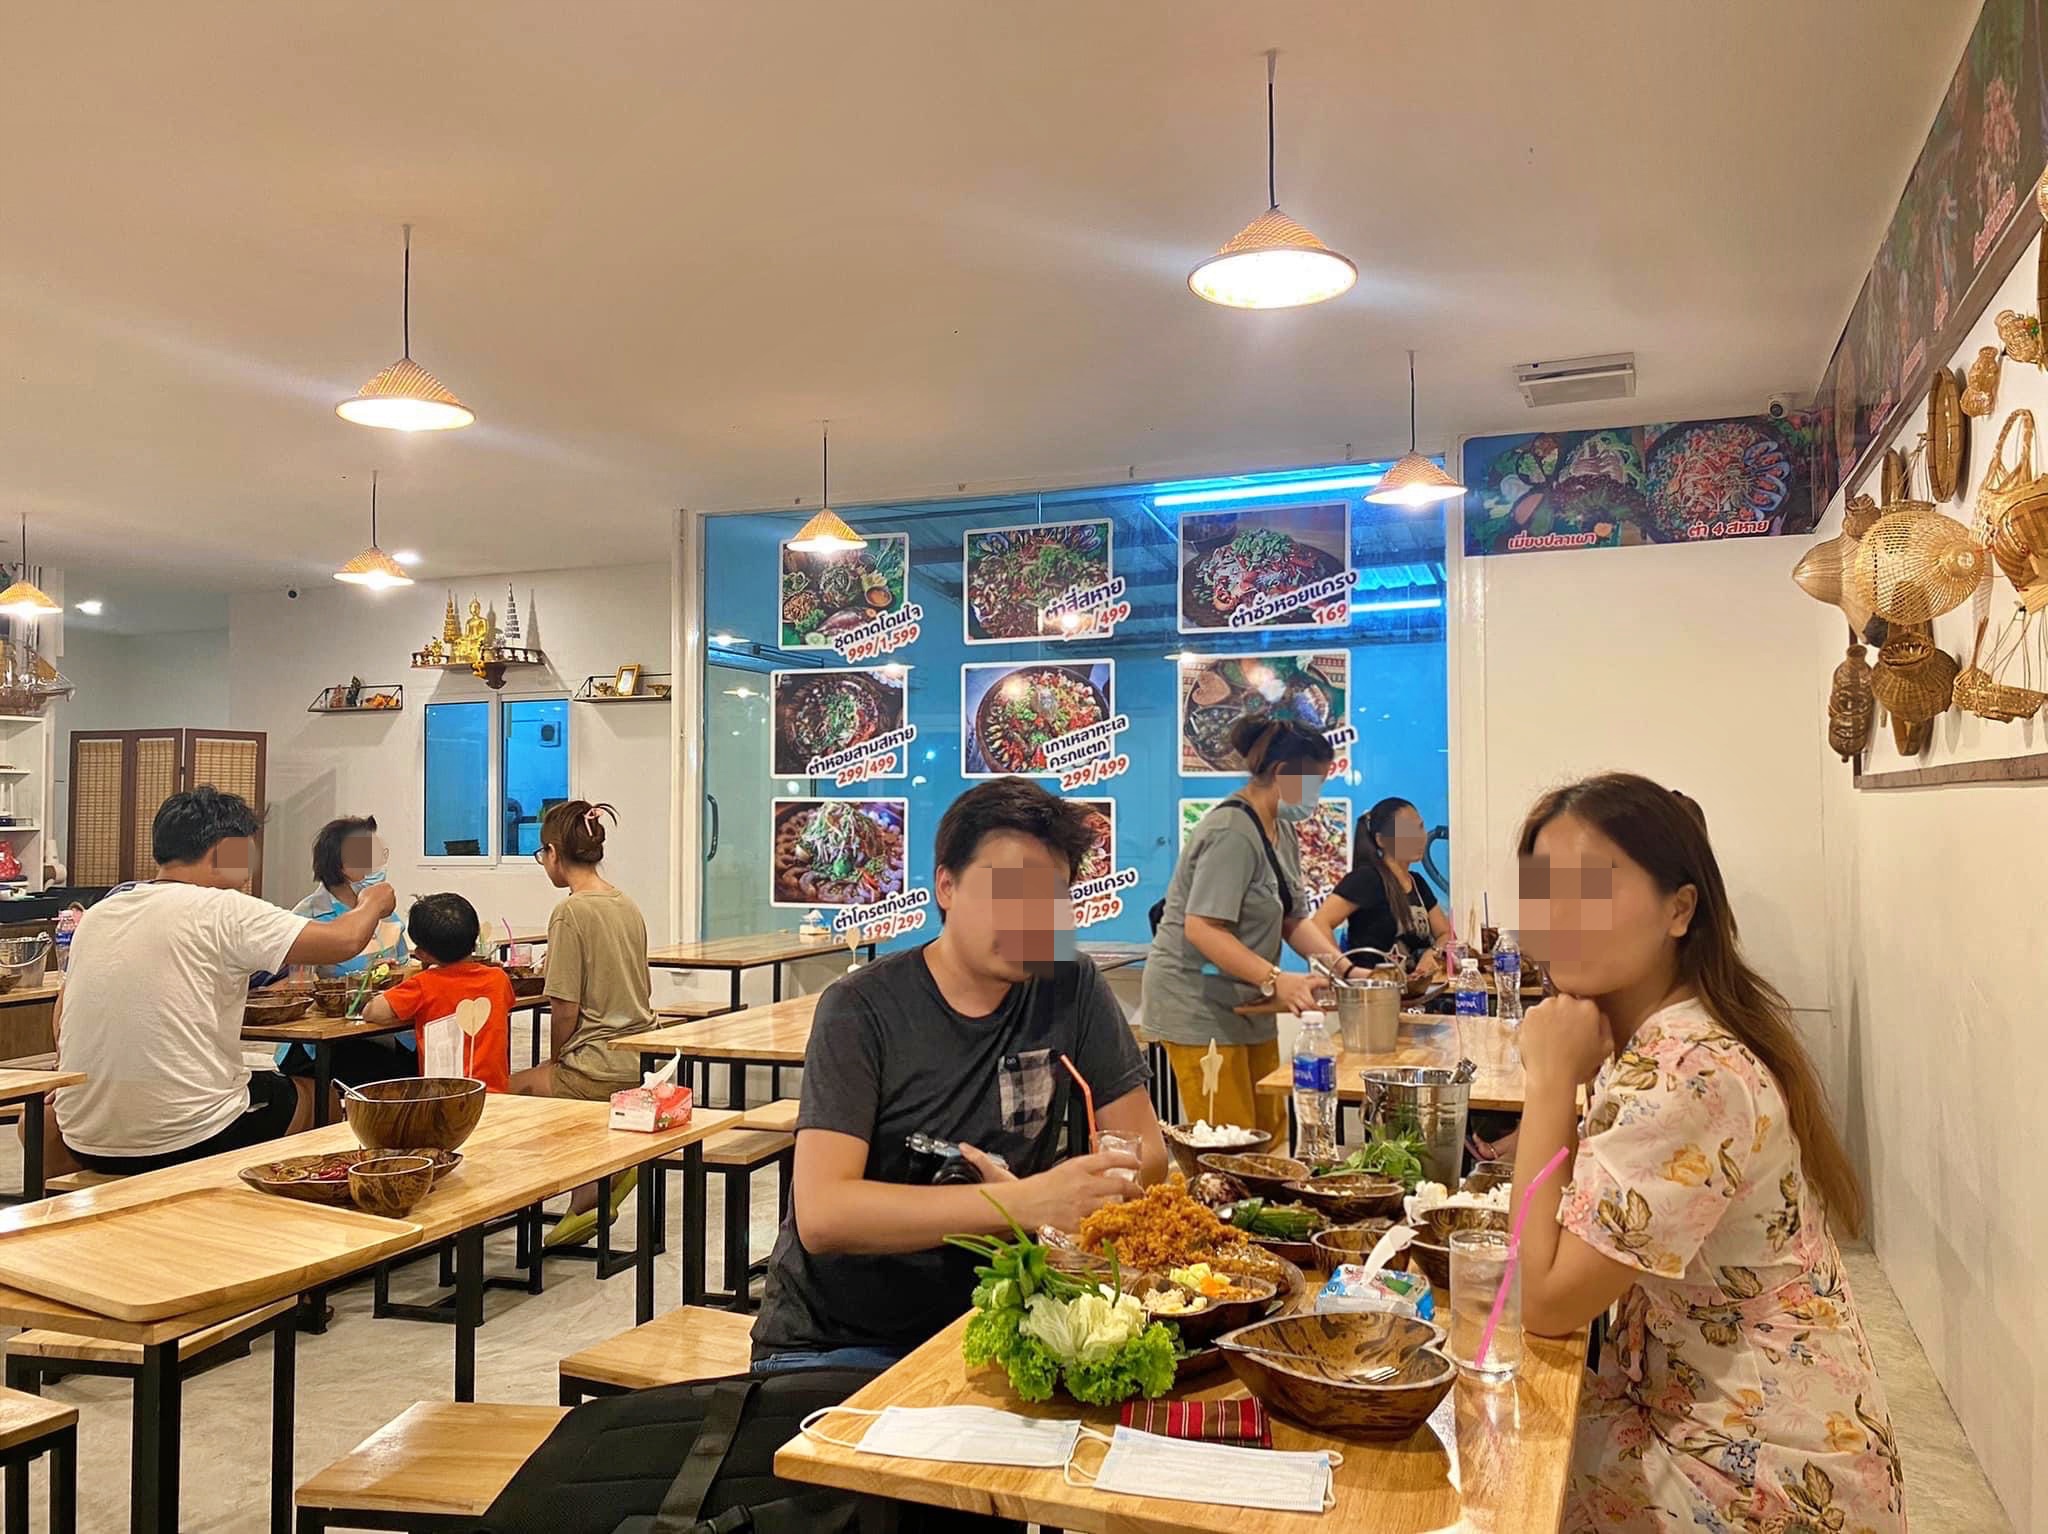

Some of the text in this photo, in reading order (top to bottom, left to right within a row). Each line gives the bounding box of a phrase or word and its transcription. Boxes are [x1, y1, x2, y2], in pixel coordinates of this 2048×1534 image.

[1712, 521, 1724, 536] 4
[1316, 603, 1347, 625] 169
[848, 625, 918, 661] 999/1,599
[837, 755, 895, 786] 299/499
[1063, 756, 1128, 788] 299/499
[866, 911, 924, 938] 199/299
